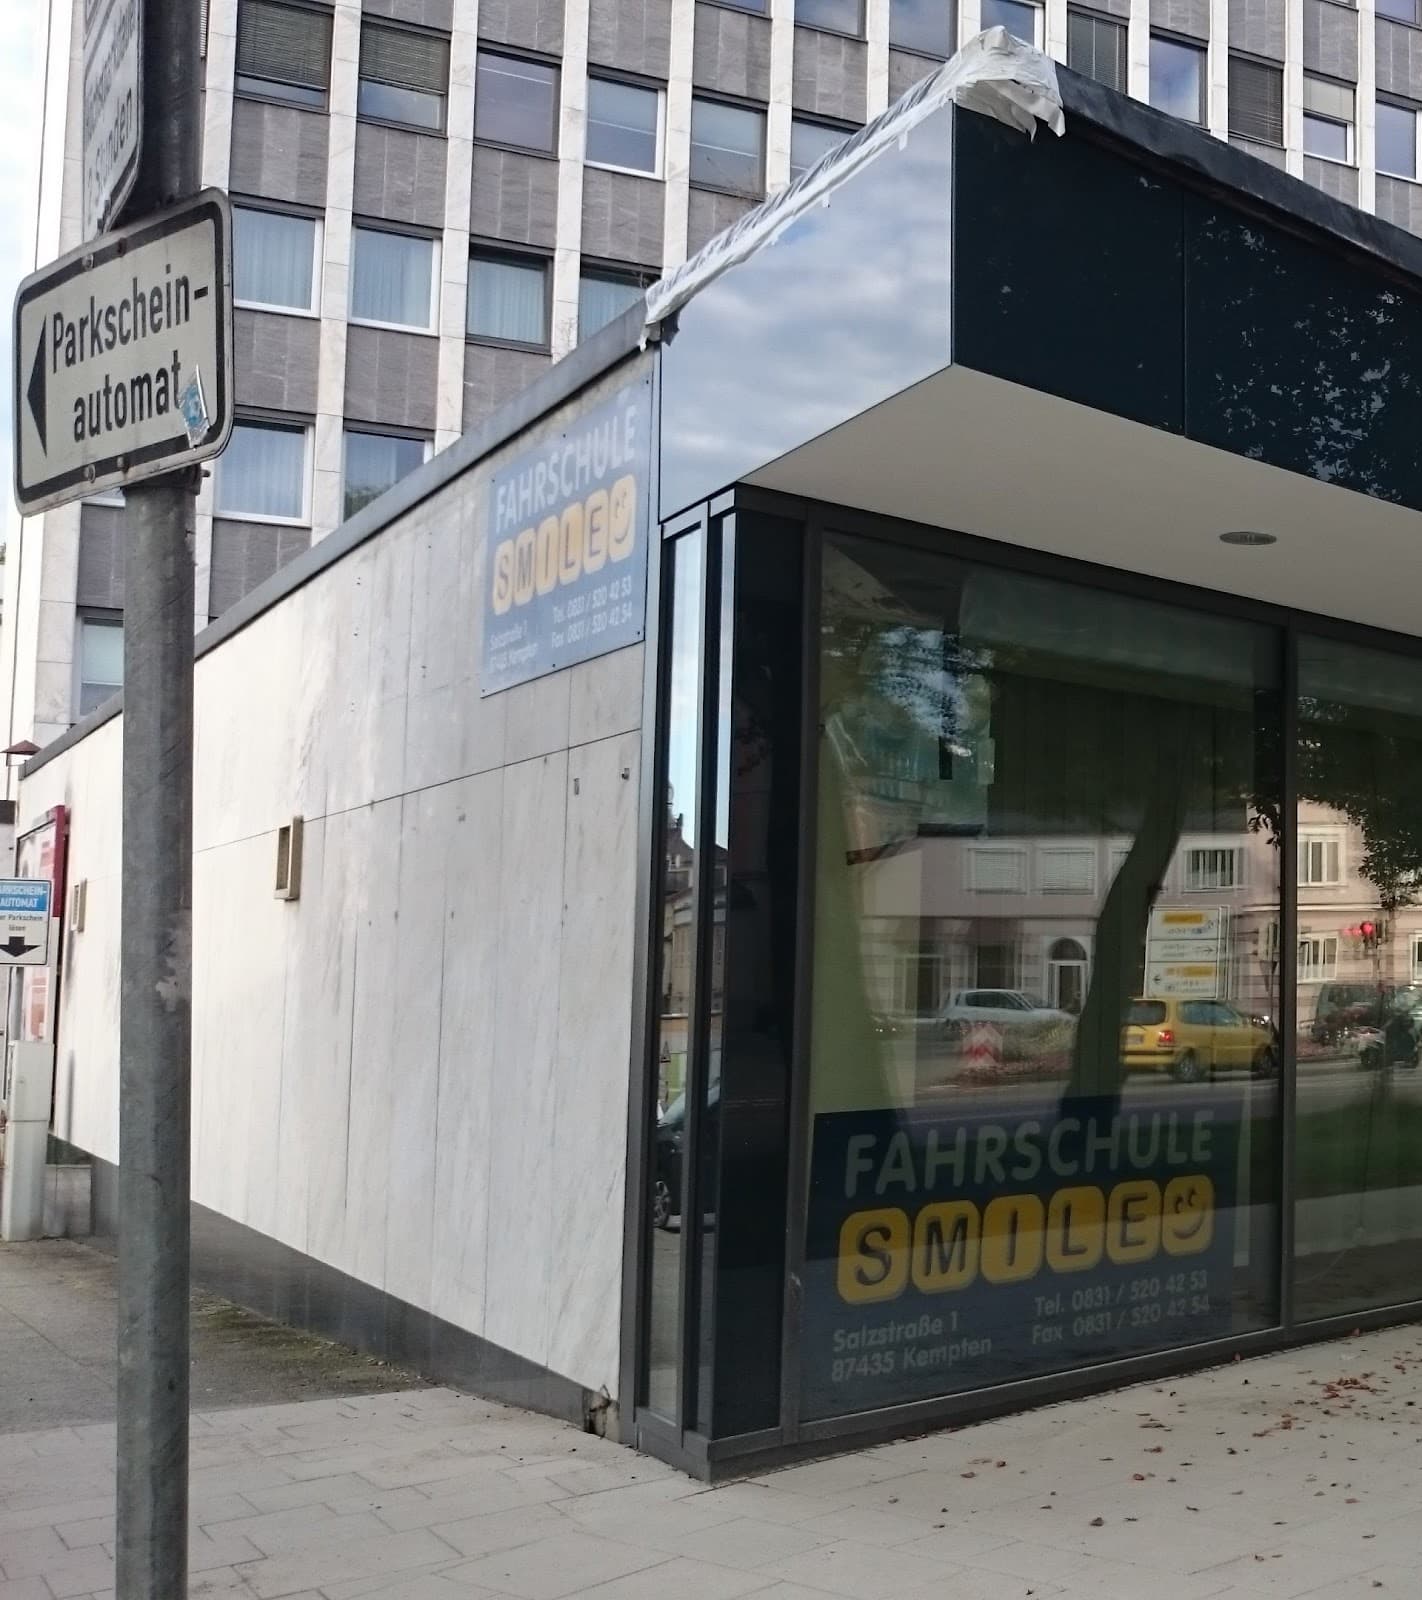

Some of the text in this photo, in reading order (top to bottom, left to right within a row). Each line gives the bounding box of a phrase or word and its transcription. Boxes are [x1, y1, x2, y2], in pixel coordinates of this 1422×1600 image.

[53, 264, 209, 374] Parkschein-
[73, 349, 182, 443] automat
[495, 404, 637, 533] FAHRSCHULE
[495, 502, 604, 602] SMILE
[843, 1110, 1215, 1199] FAHRSCHULE
[852, 1190, 1150, 1287] SMILE
[833, 1310, 959, 1352] Salzstraße 1
[1032, 1324, 1063, 1345] Fax
[1072, 1311, 1112, 1338] 0831
[1130, 1303, 1161, 1327] 520
[1167, 1300, 1185, 1317] 42
[1191, 1294, 1210, 1316] 54
[1034, 1292, 1065, 1317] Tel.
[1071, 1284, 1111, 1312] 0831
[1130, 1277, 1161, 1301] 520
[1165, 1272, 1184, 1293] 42
[1190, 1268, 1208, 1291] 53
[831, 1337, 993, 1383] 87435 Kempten
